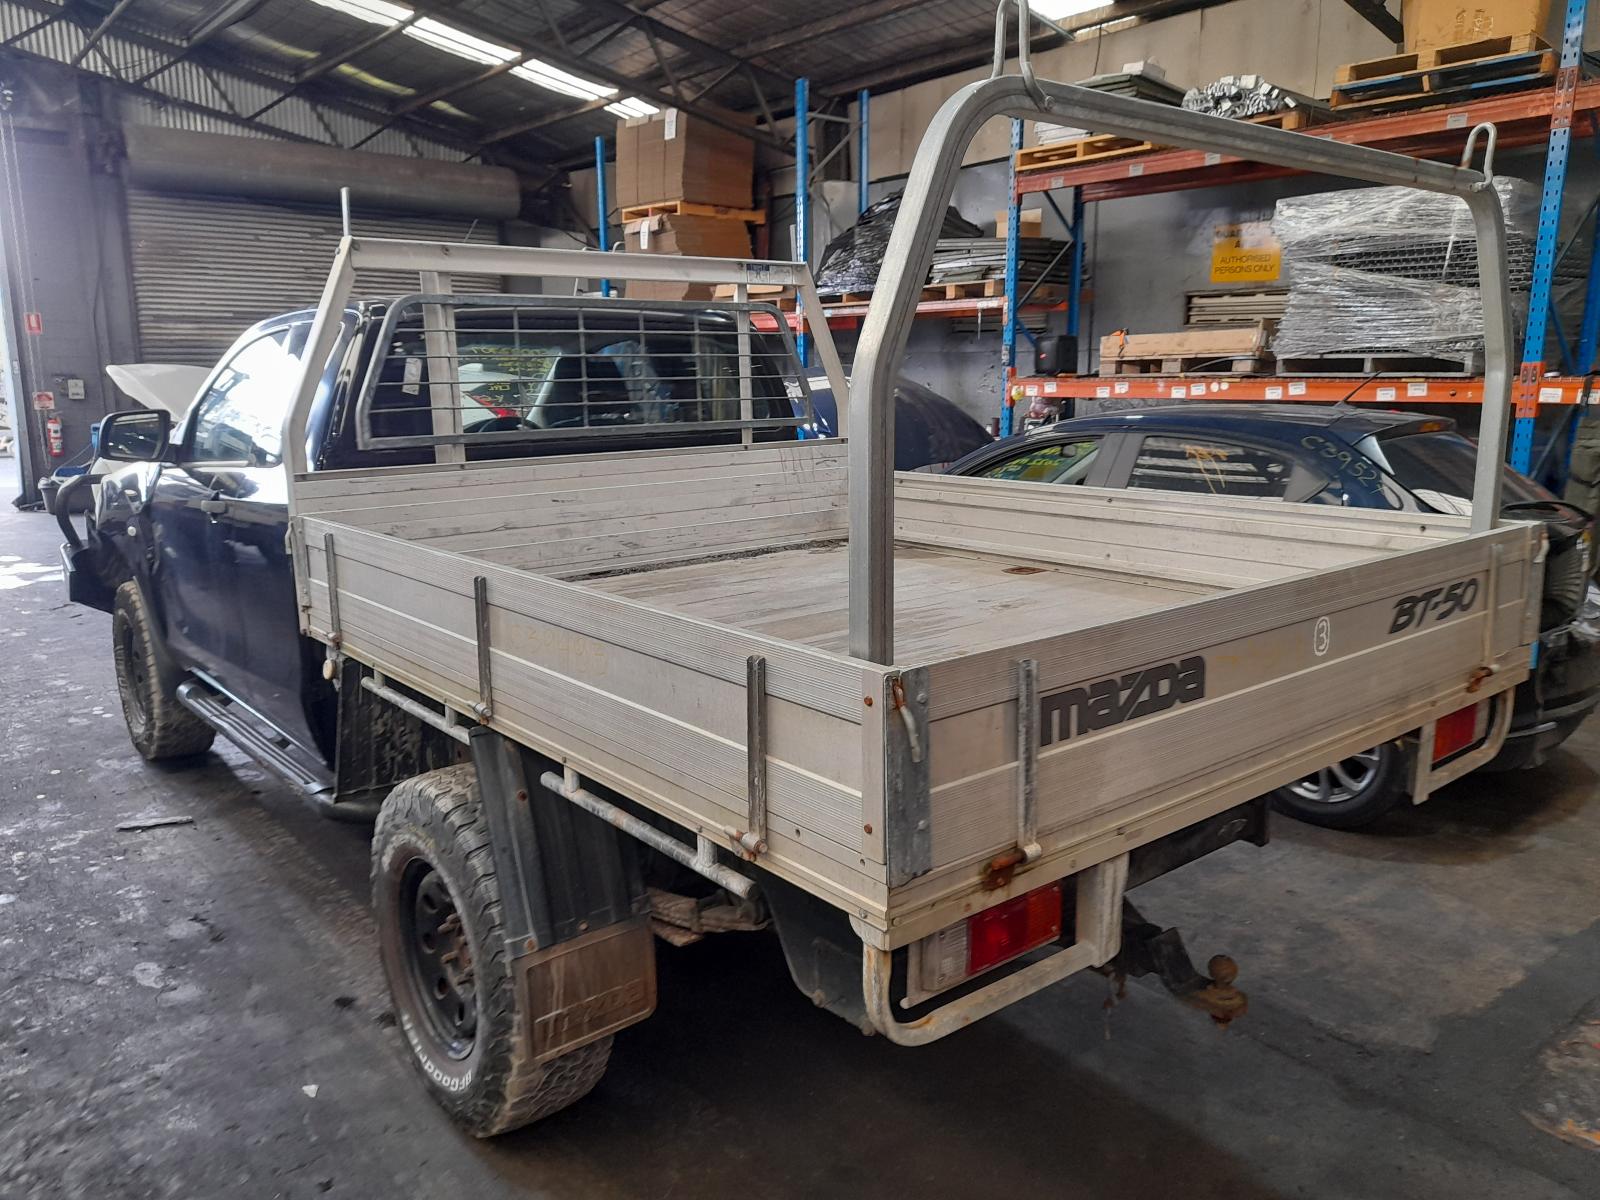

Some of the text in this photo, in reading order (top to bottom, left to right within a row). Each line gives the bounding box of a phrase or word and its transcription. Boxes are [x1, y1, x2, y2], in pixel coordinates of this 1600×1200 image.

[1219, 254, 1271, 265] AUTHORISED
[1214, 263, 1275, 274] PERSONS ONLY
[1388, 578, 1479, 634] BT-50
